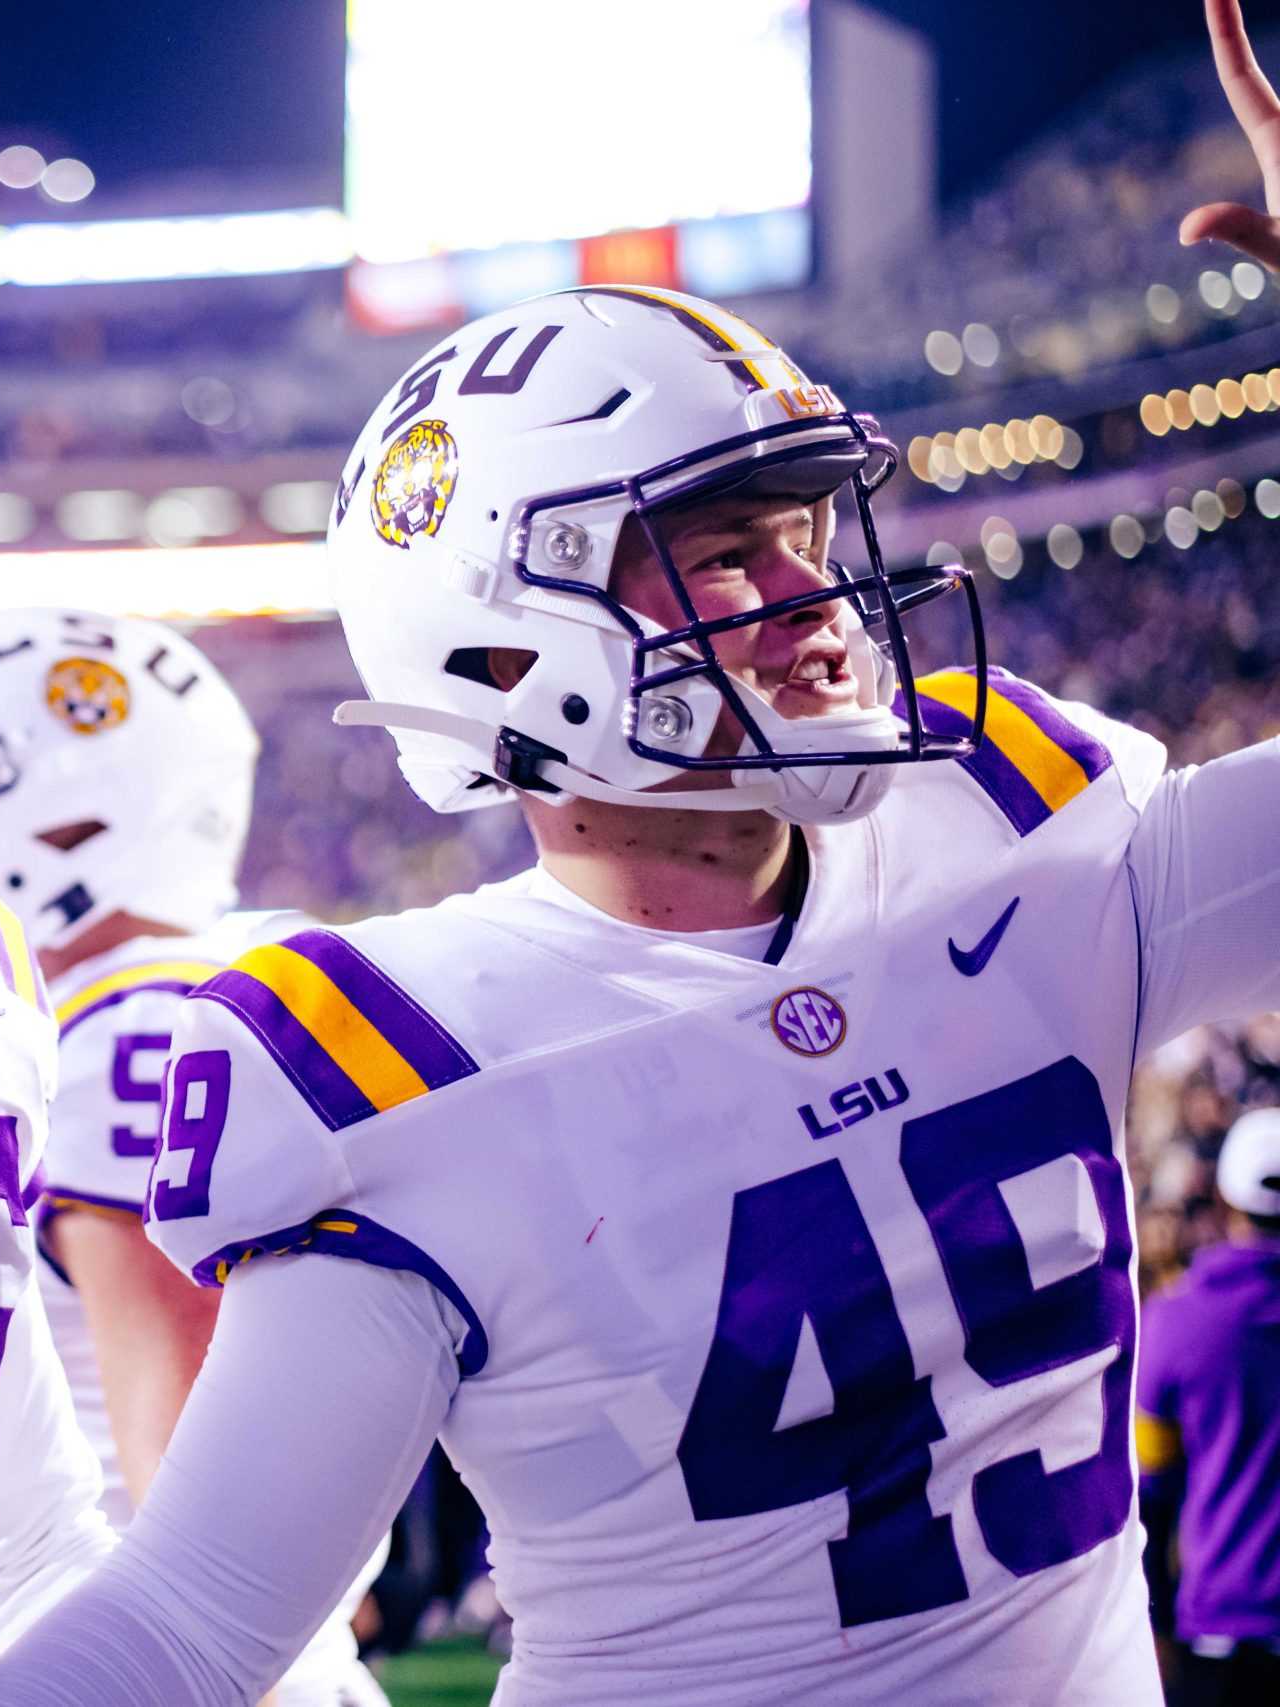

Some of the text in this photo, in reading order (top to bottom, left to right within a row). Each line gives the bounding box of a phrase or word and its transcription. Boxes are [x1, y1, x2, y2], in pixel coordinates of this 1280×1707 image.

[336, 325, 565, 529] LSU
[777, 991, 842, 1053] SEC
[797, 1067, 910, 1140] LSU
[676, 1055, 1135, 1628] 49
